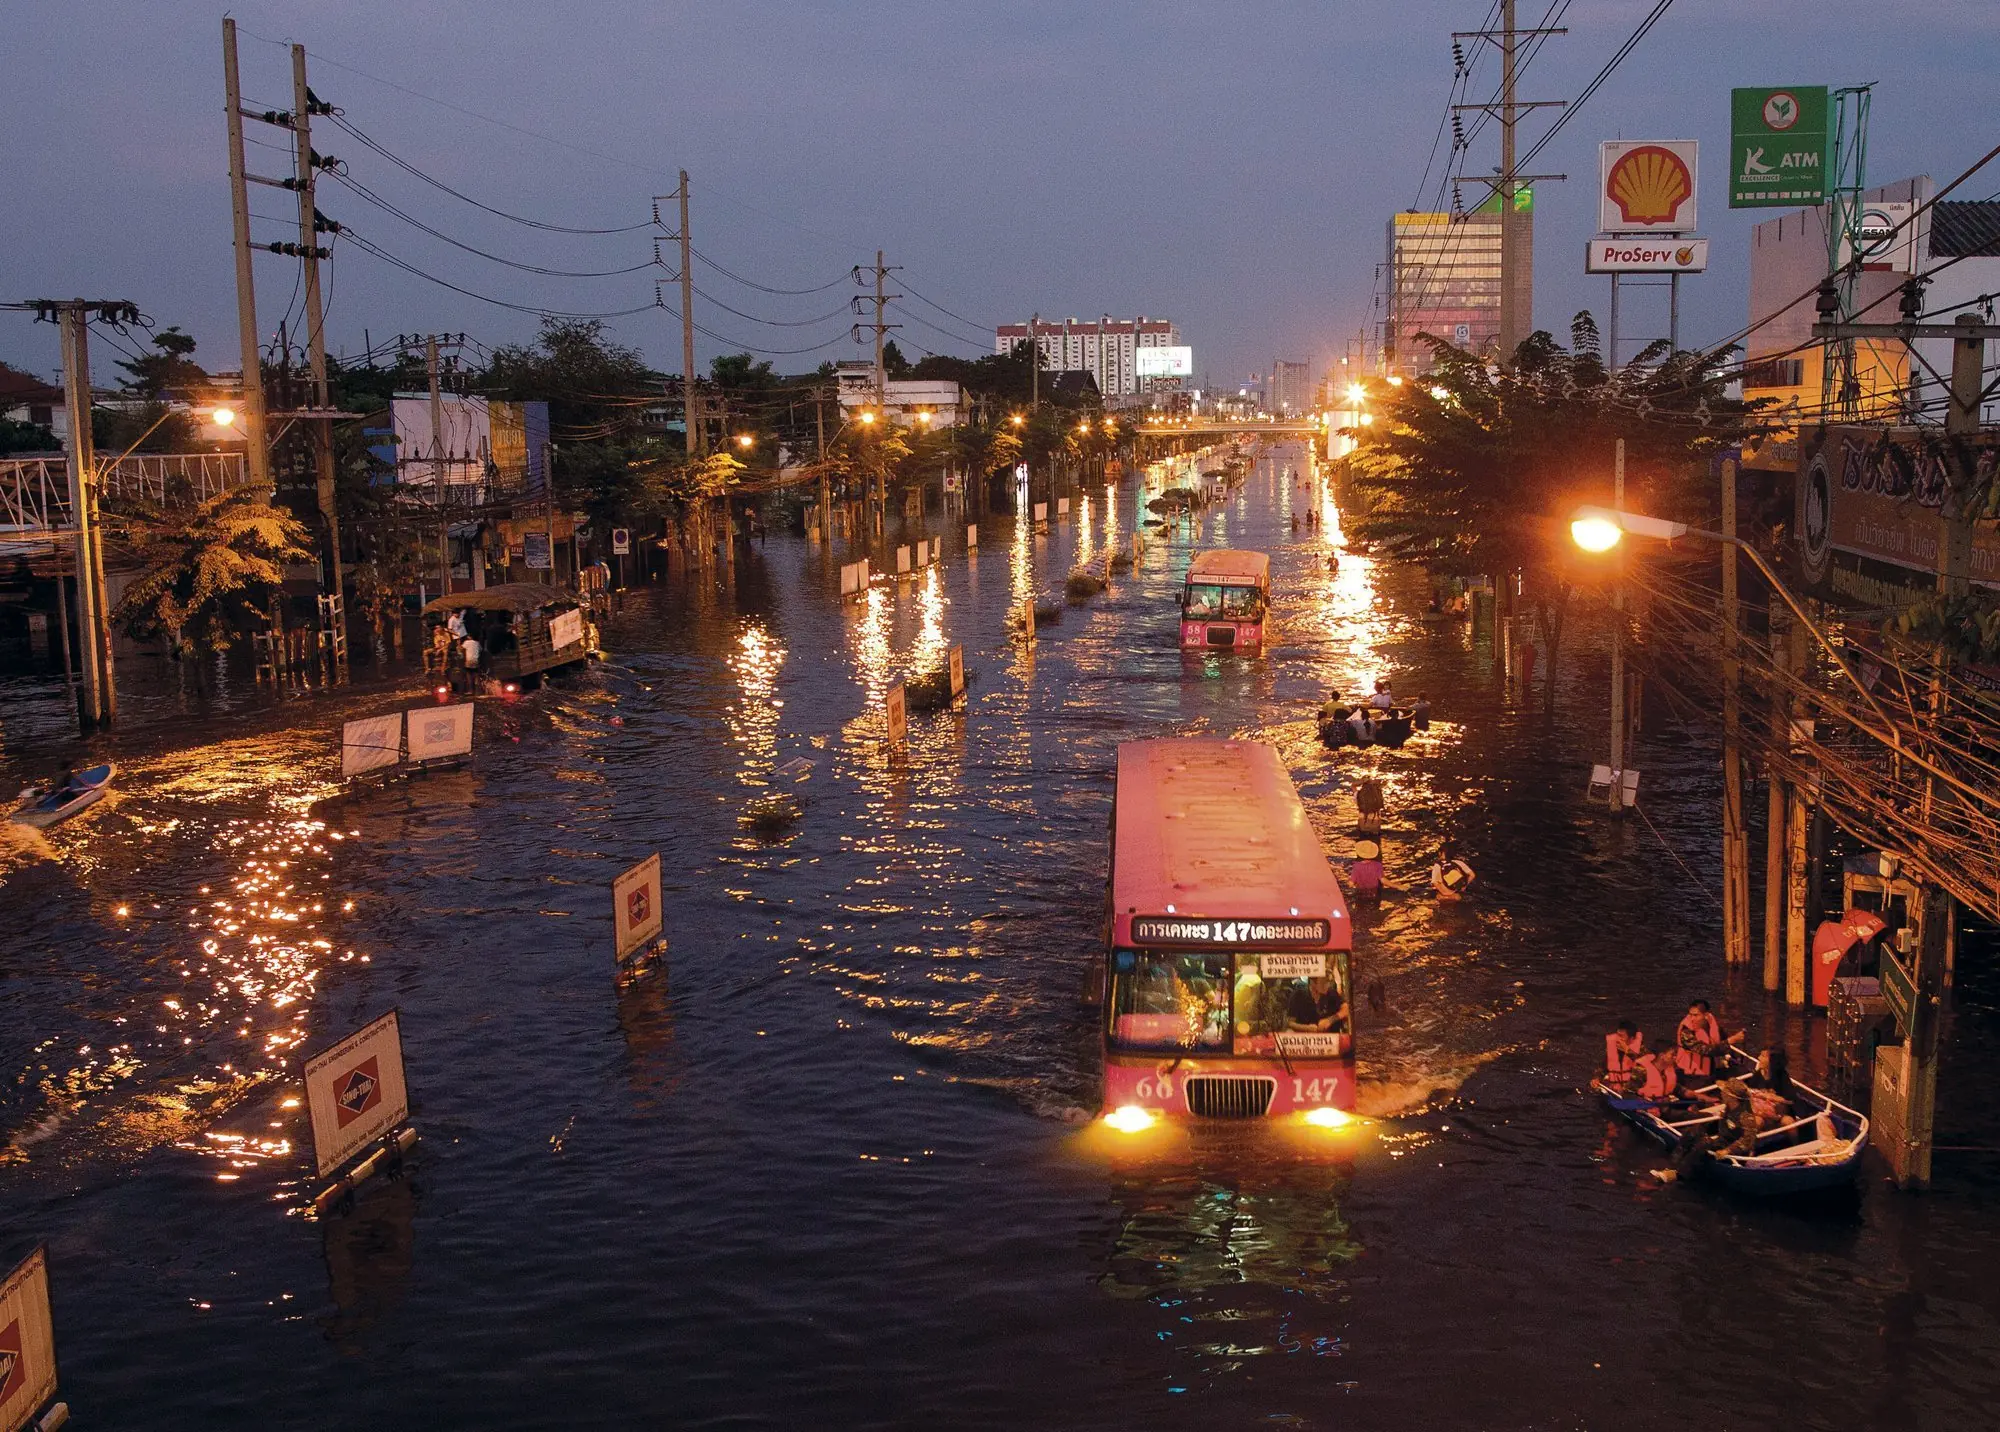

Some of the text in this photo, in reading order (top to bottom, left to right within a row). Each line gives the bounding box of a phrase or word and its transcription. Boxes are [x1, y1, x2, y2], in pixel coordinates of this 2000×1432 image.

[1780, 152, 1819, 168] ATM
[1741, 174, 1780, 182] EXCELLENCE
[1603, 247, 1672, 263] ProServ
[1240, 628, 1256, 637] 147
[1213, 922, 1251, 942] 147
[342, 1079, 372, 1105] SINO-THAI
[1292, 1077, 1339, 1103] 147
